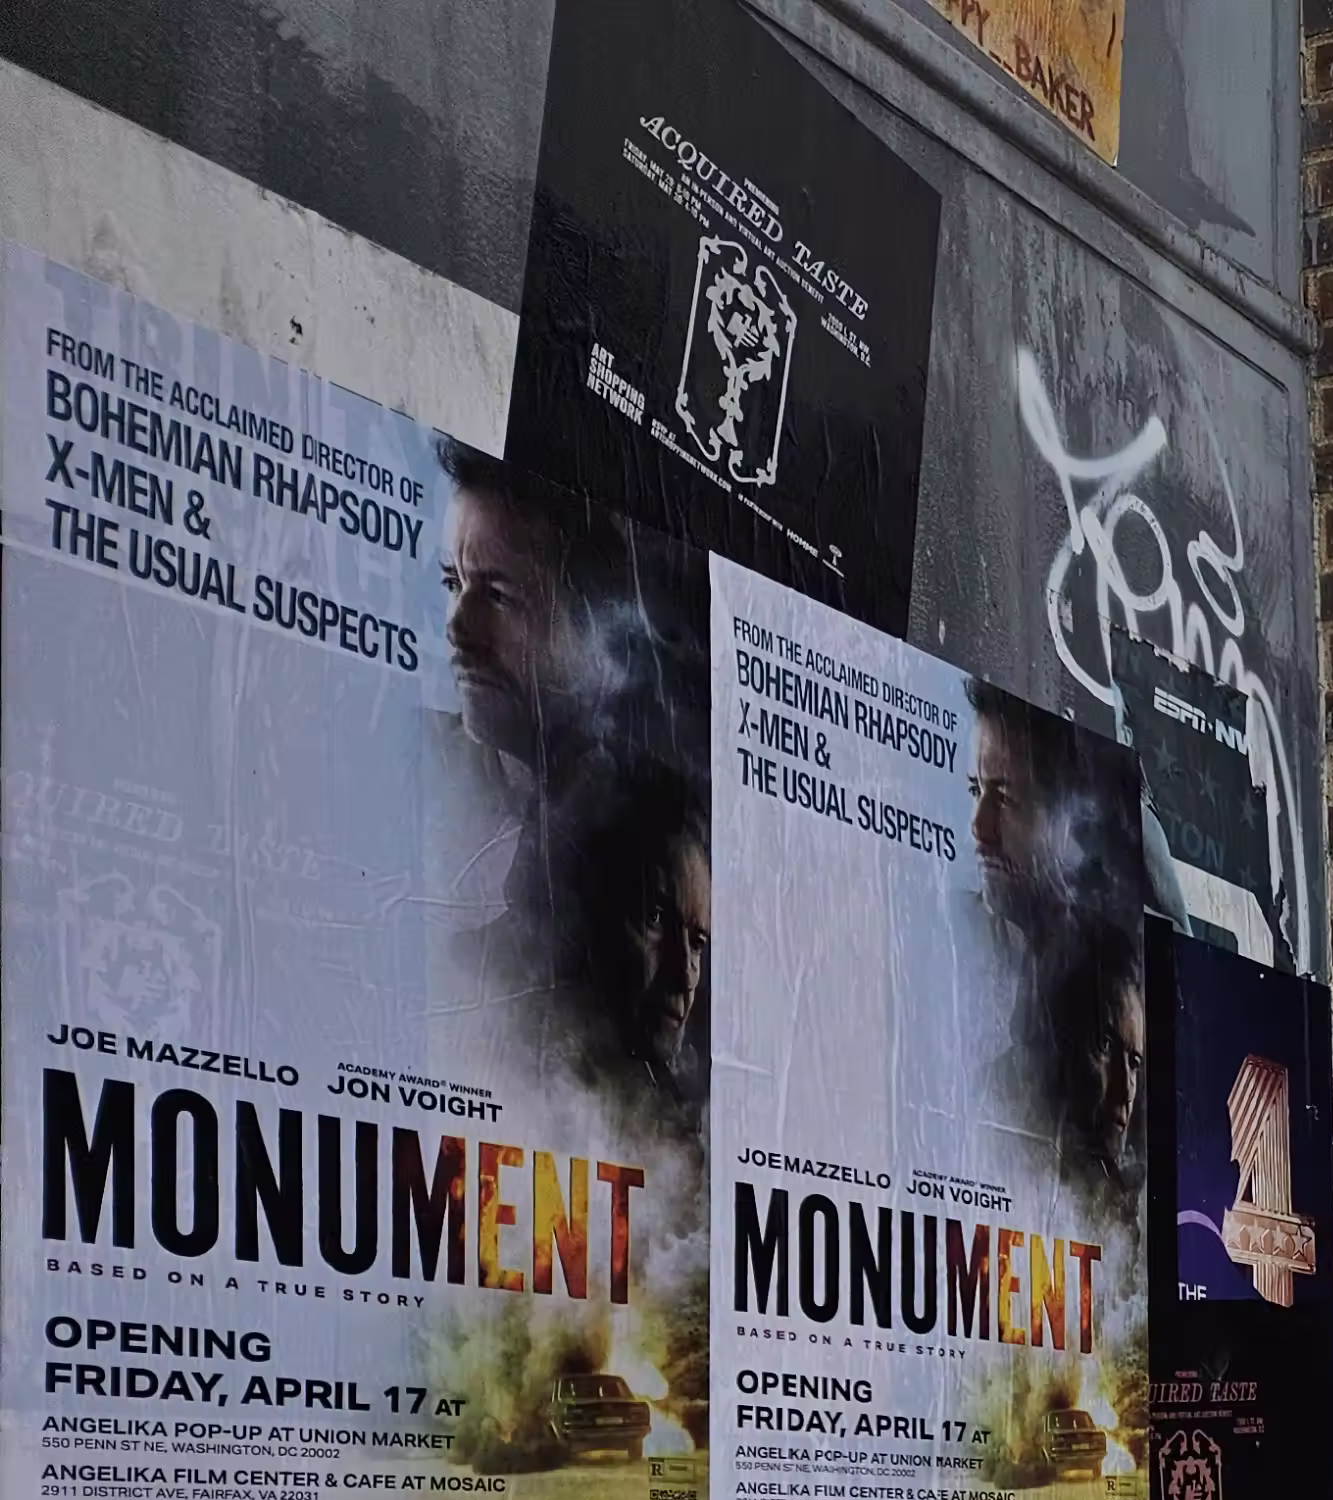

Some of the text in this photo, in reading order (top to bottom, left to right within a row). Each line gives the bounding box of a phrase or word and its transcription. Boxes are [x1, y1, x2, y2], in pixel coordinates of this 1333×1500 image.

[1014, 34, 1095, 141] BAKER
[639, 115, 869, 320] ACQUIRED TASTE
[591, 342, 614, 367] ART
[587, 374, 644, 425] NETWORK
[589, 357, 645, 410] SHOPPING
[47, 328, 423, 506] FROM THE ACCLAIMED DIRECTOR OF
[46, 433, 211, 540] X-MEN &
[47, 369, 423, 558] BOHEMIAN RHAPSODY
[787, 528, 819, 557] HOMME
[46, 498, 418, 672] THE USUAL SUSPECTS
[736, 650, 957, 773] BOHEMIAN RHAPSODY
[738, 699, 830, 770] X-MEN &
[738, 748, 955, 862] THE USUAL SUSPECTS
[48, 1025, 298, 1086] JOE MAZZELLO
[337, 1063, 396, 1081] ACADEMY
[449, 1082, 492, 1098] WINNER
[328, 1075, 502, 1123] JON VOIGHT
[43, 1068, 644, 1304] MONUMENT
[47, 1259, 426, 1308] BASED ON A TRUE STORY
[734, 1181, 1102, 1354] MONUMENT
[46, 1316, 271, 1362] OPENING
[46, 1362, 465, 1416] FRIDAY, APRIL 17 AT
[737, 1370, 873, 1403] OPENING
[1210, 1382, 1257, 1401] TASTE
[42, 1417, 454, 1449] ANGELIKA POP-UP AT UNION MARKET
[42, 1437, 69, 1448] 550
[74, 1439, 116, 1450] PENN
[121, 1440, 141, 1451] ST
[279, 1447, 297, 1457] DC
[301, 1447, 339, 1458] 20002
[737, 1405, 967, 1444] FRIDAY, APRIL 17
[41, 1486, 77, 1497] 2911
[83, 1487, 152, 1498] DISTRICT
[259, 1491, 278, 1500] VA
[280, 1491, 318, 1500] 22031
[42, 1465, 505, 1492] ANGELIKA FILM CENTER & CAFE AT MOSAIC
